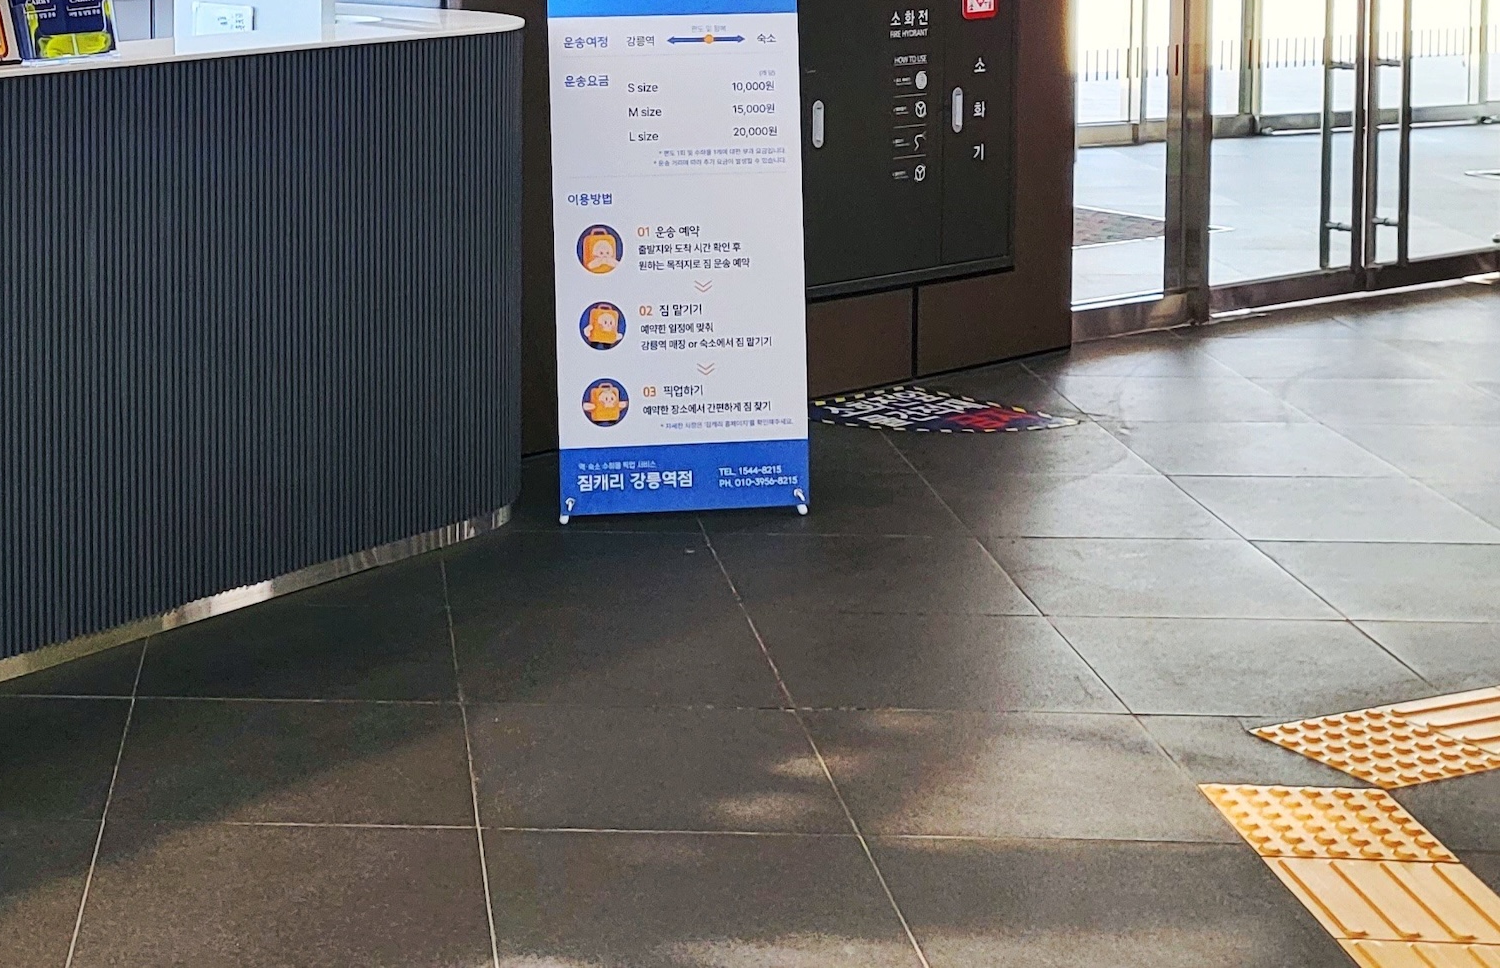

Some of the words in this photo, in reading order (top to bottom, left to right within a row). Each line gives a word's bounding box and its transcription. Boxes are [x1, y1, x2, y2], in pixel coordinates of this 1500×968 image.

[890, 9, 929, 26] 소화전
[564, 36, 608, 49] 운송여정
[626, 35, 655, 47] 강릉역
[757, 33, 777, 44] 숙소
[564, 76, 610, 88] 운송요금
[628, 83, 635, 93] S
[637, 83, 659, 93] size
[732, 81, 775, 93] 10,000원
[628, 108, 639, 118] M
[641, 107, 662, 118] size
[732, 103, 775, 115] 15,000원
[629, 132, 636, 142] L
[637, 131, 659, 142] size
[733, 126, 778, 138] 20,000원
[567, 193, 613, 206] 이용방법
[637, 227, 650, 237] 01
[655, 226, 676, 238] 운송
[679, 225, 700, 238] 예약
[638, 244, 672, 255] 출발지와
[675, 243, 692, 253] 도착
[694, 242, 711, 253] 시간
[713, 242, 730, 252] 확인
[732, 242, 741, 251] 후
[639, 261, 664, 271] 원하는
[667, 259, 700, 270] 목적지로
[703, 259, 711, 269] 짐
[732, 257, 750, 268] 예약
[639, 305, 653, 317] 02
[659, 304, 669, 317] 짐
[640, 323, 666, 334] 예약한
[641, 340, 667, 350] 강릉역
[700, 338, 734, 348] 숙소에서
[736, 337, 744, 347] 짐
[643, 386, 657, 397] 03
[663, 385, 704, 398] 픽업하기
[642, 405, 669, 416] 예약한
[671, 403, 705, 415] 장소에서
[707, 402, 741, 413] 간편하게
[743, 401, 752, 412] 짐
[754, 400, 771, 411] 찾기
[738, 465, 782, 475] 1544-8215
[577, 473, 624, 492] 짐캐리
[630, 470, 693, 490] 강릉역점
[734, 476, 798, 487] 010-3956-8215
